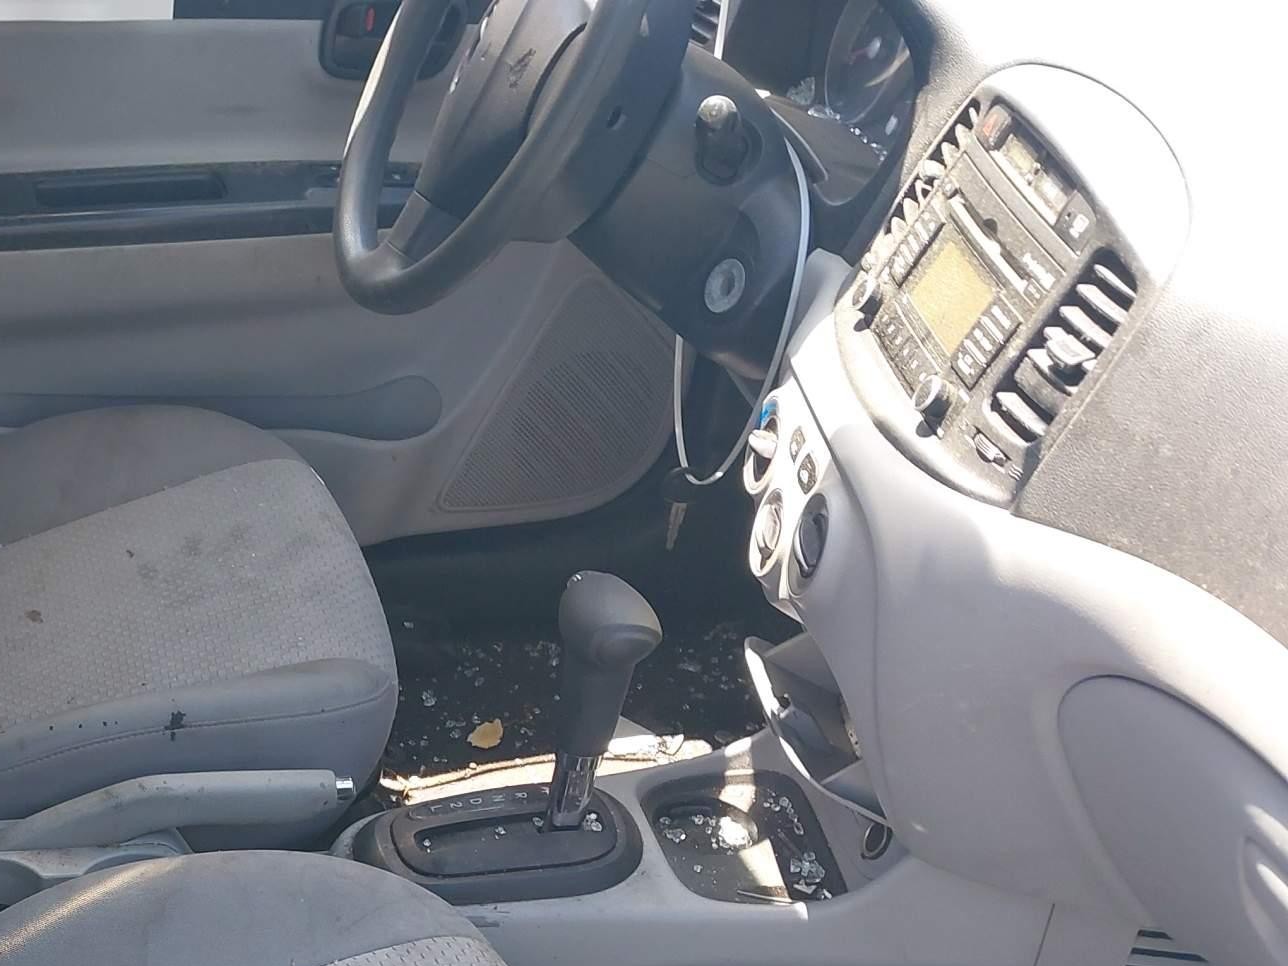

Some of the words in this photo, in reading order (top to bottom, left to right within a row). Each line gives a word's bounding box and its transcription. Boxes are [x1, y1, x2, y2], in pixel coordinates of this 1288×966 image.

[492, 793, 505, 802] N
[514, 791, 528, 799] R
[450, 801, 463, 809] 2
[470, 797, 482, 805] D
[430, 804, 443, 812] L
